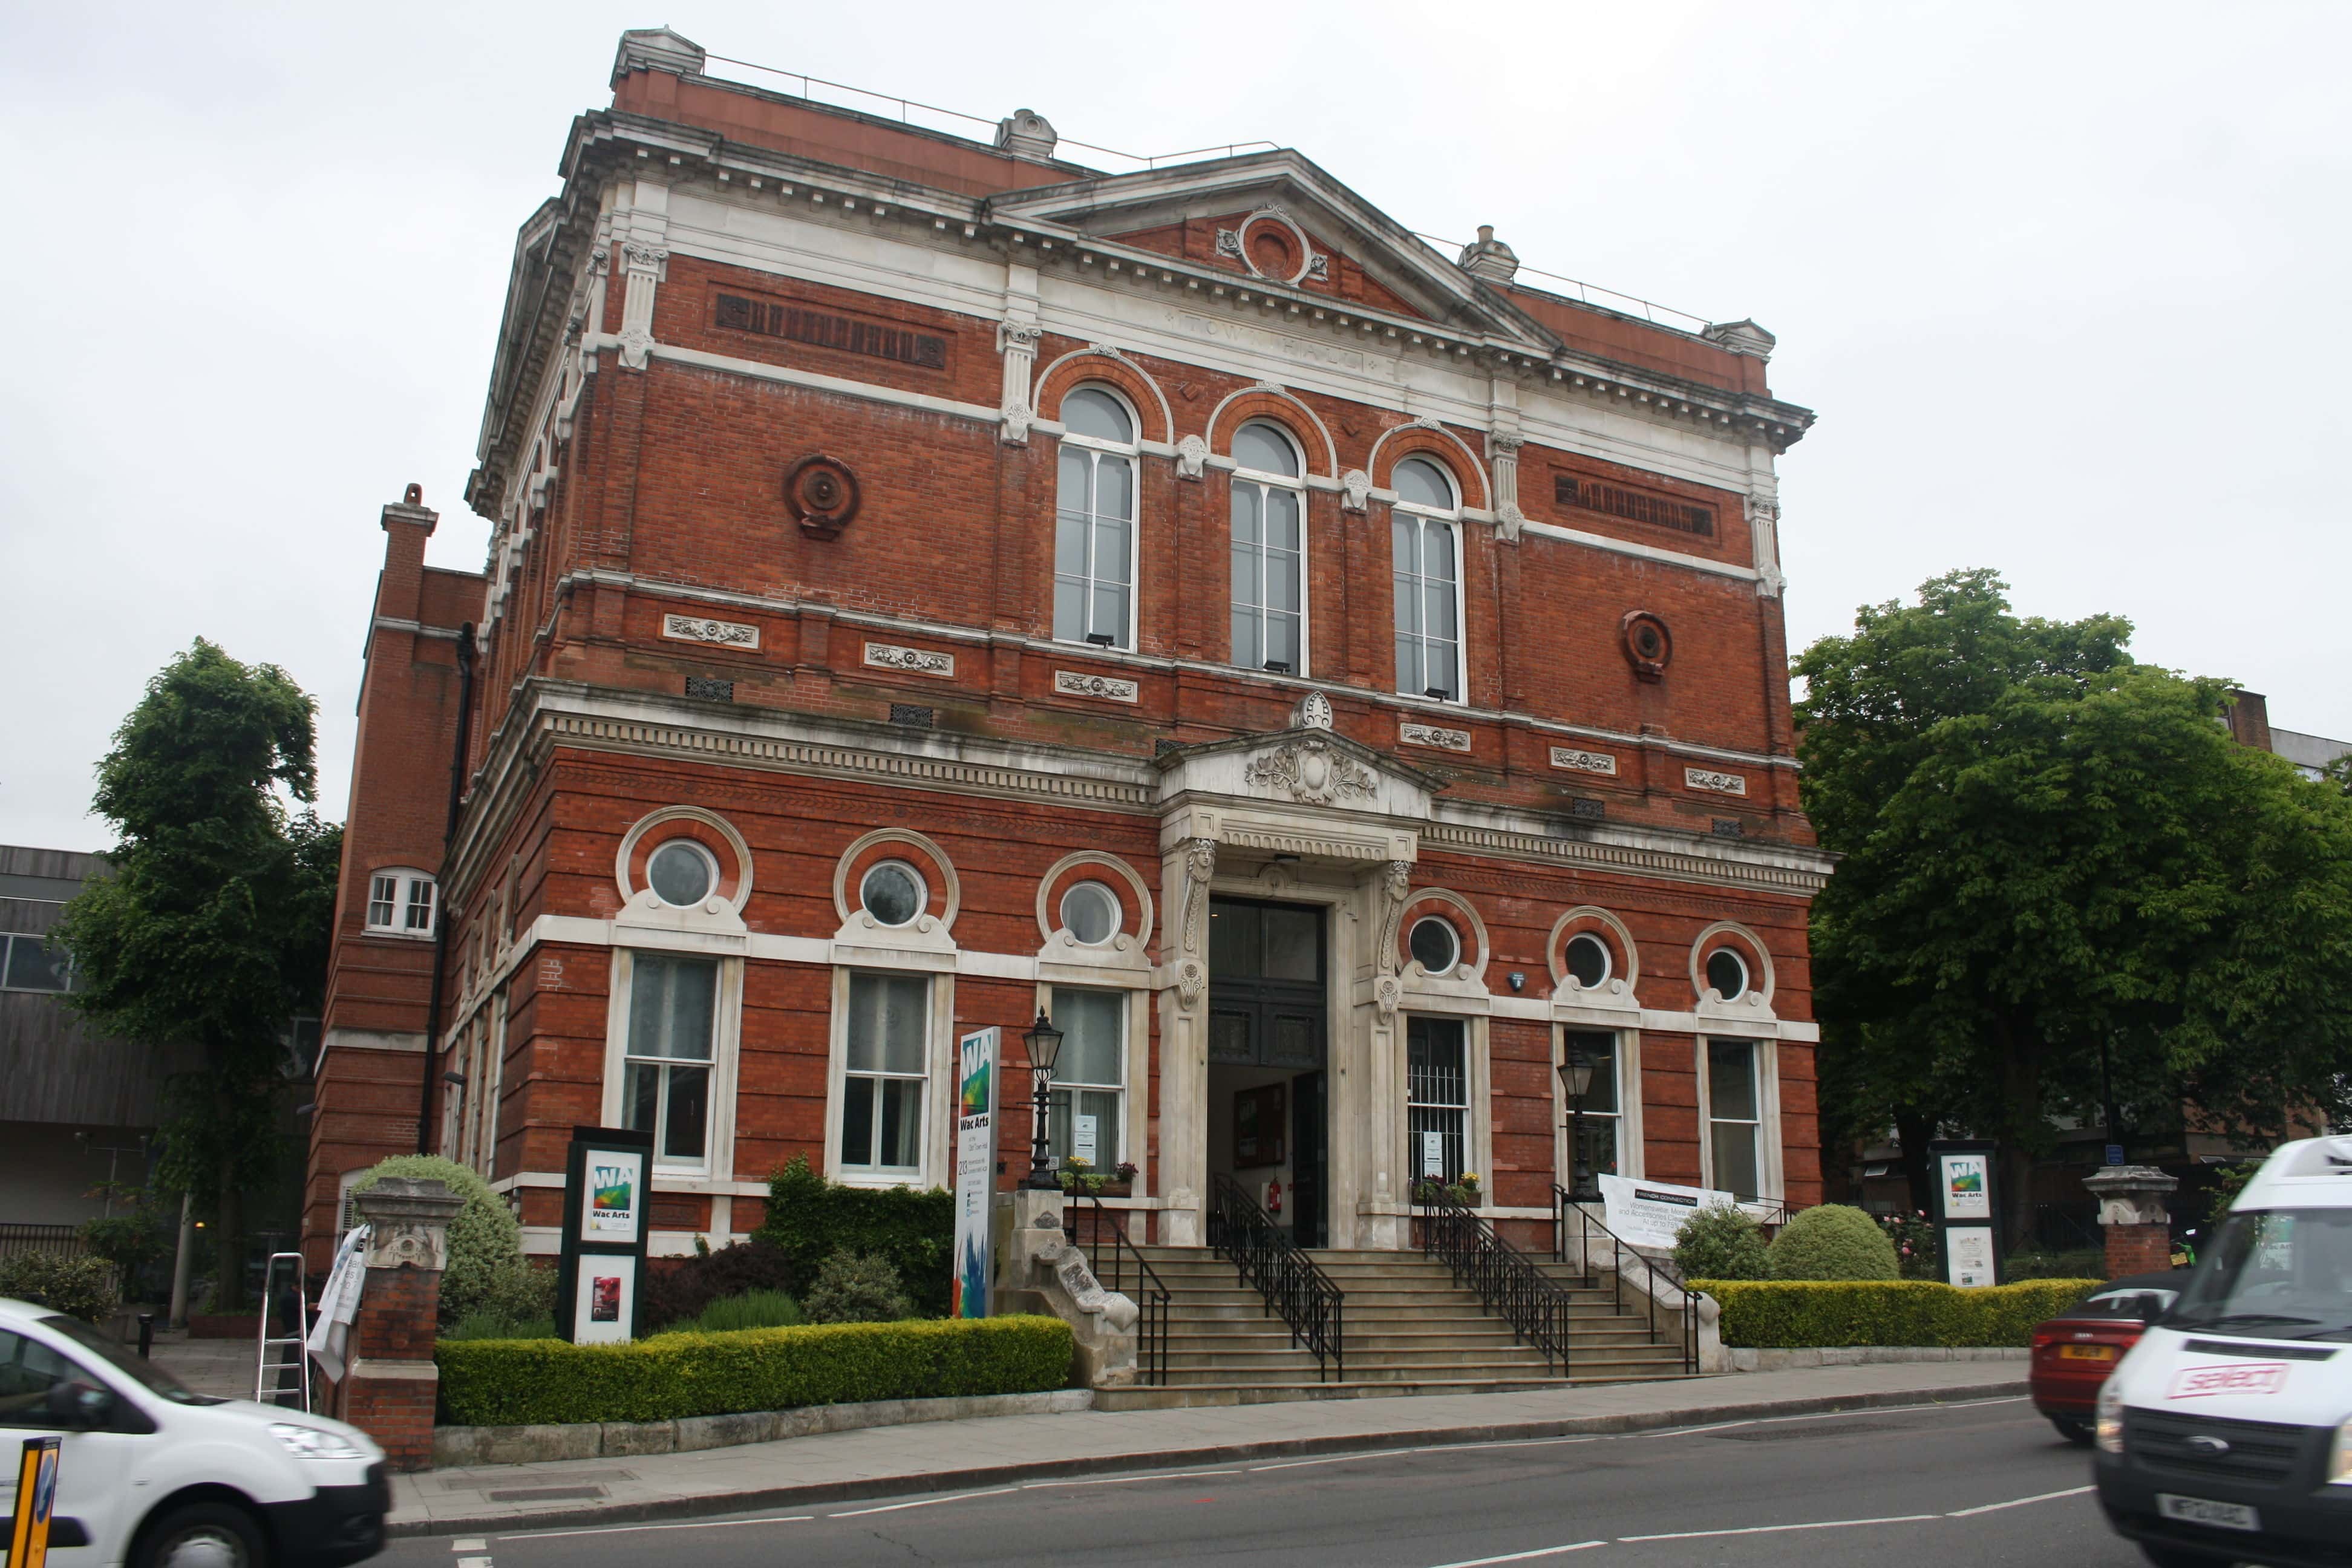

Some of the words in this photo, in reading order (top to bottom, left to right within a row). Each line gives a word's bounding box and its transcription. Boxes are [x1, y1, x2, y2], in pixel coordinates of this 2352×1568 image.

[1282, 338, 1358, 368] HALL
[961, 1119, 973, 1131] Wac
[975, 1117, 988, 1128] Arts
[958, 1160, 968, 1175] 213
[1636, 1191, 1659, 1200] FRENCH
[1660, 1195, 1696, 1205] CONNECTION
[1631, 1210, 1667, 1220] Accessories
